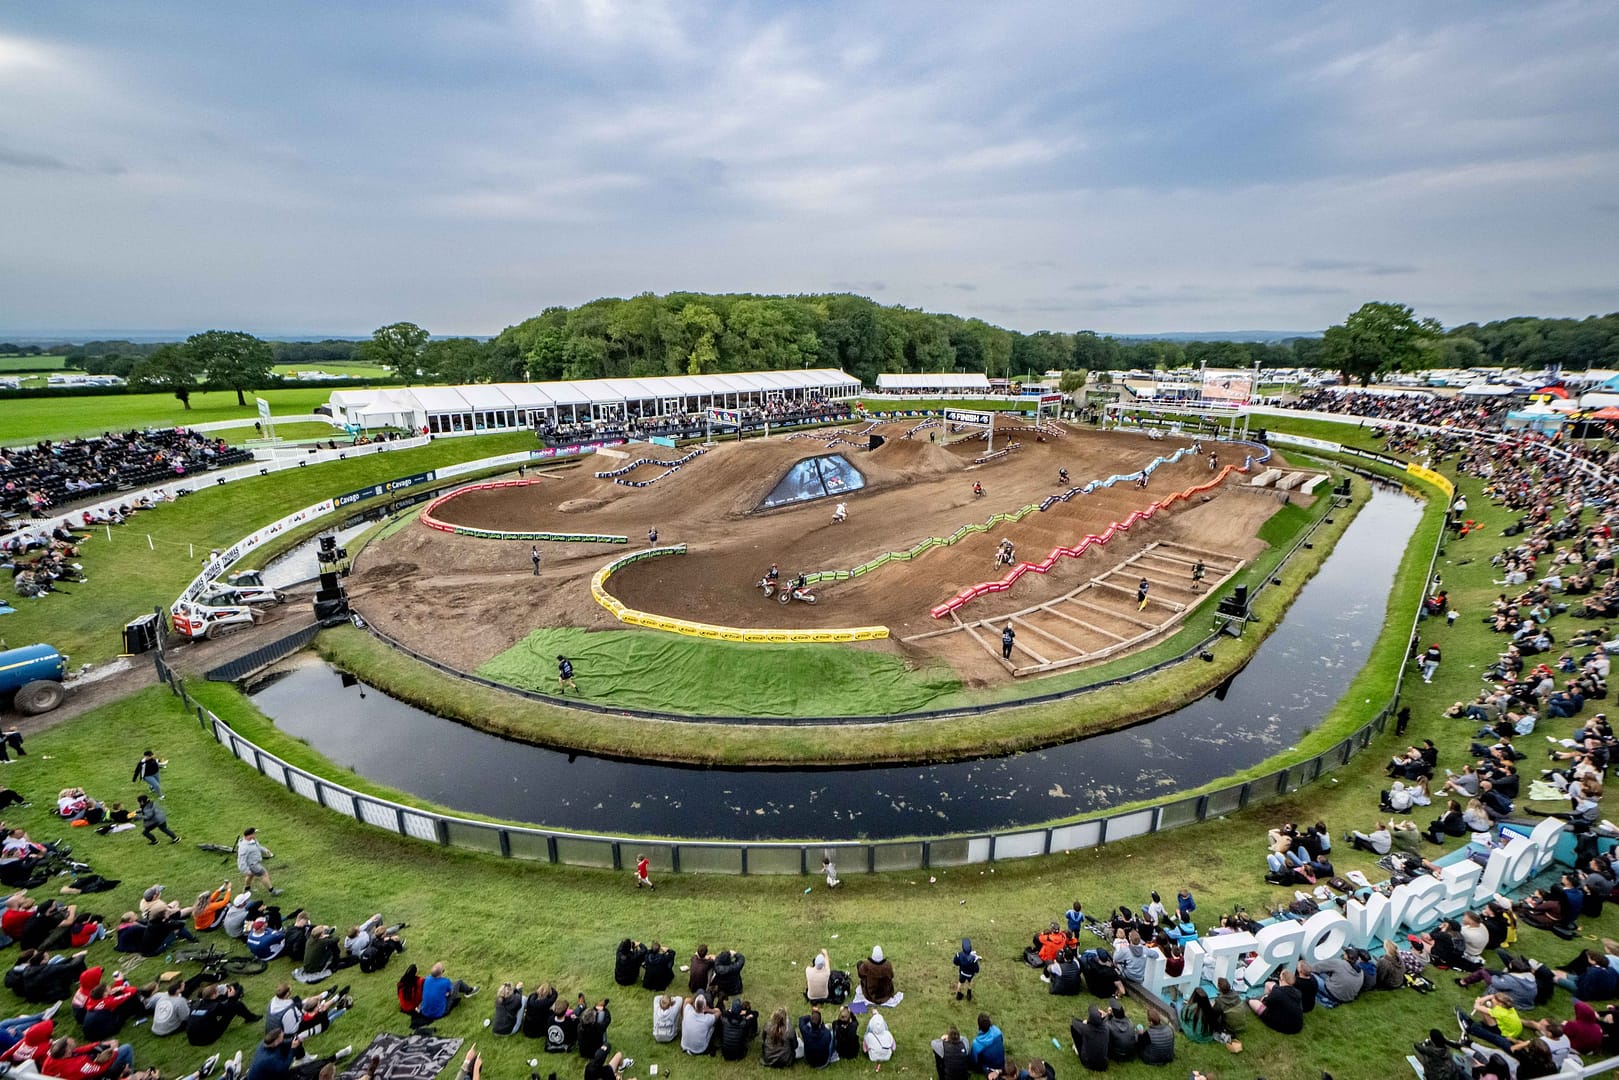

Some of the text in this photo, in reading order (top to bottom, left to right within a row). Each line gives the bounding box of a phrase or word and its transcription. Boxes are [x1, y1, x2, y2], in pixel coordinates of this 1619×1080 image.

[956, 413, 980, 423] FINISH
[391, 479, 412, 489] Cavago
[340, 493, 360, 505] Cavago
[221, 546, 239, 564] THOMAS
[204, 561, 221, 580] THOMAS
[188, 577, 204, 595] THOMAS
